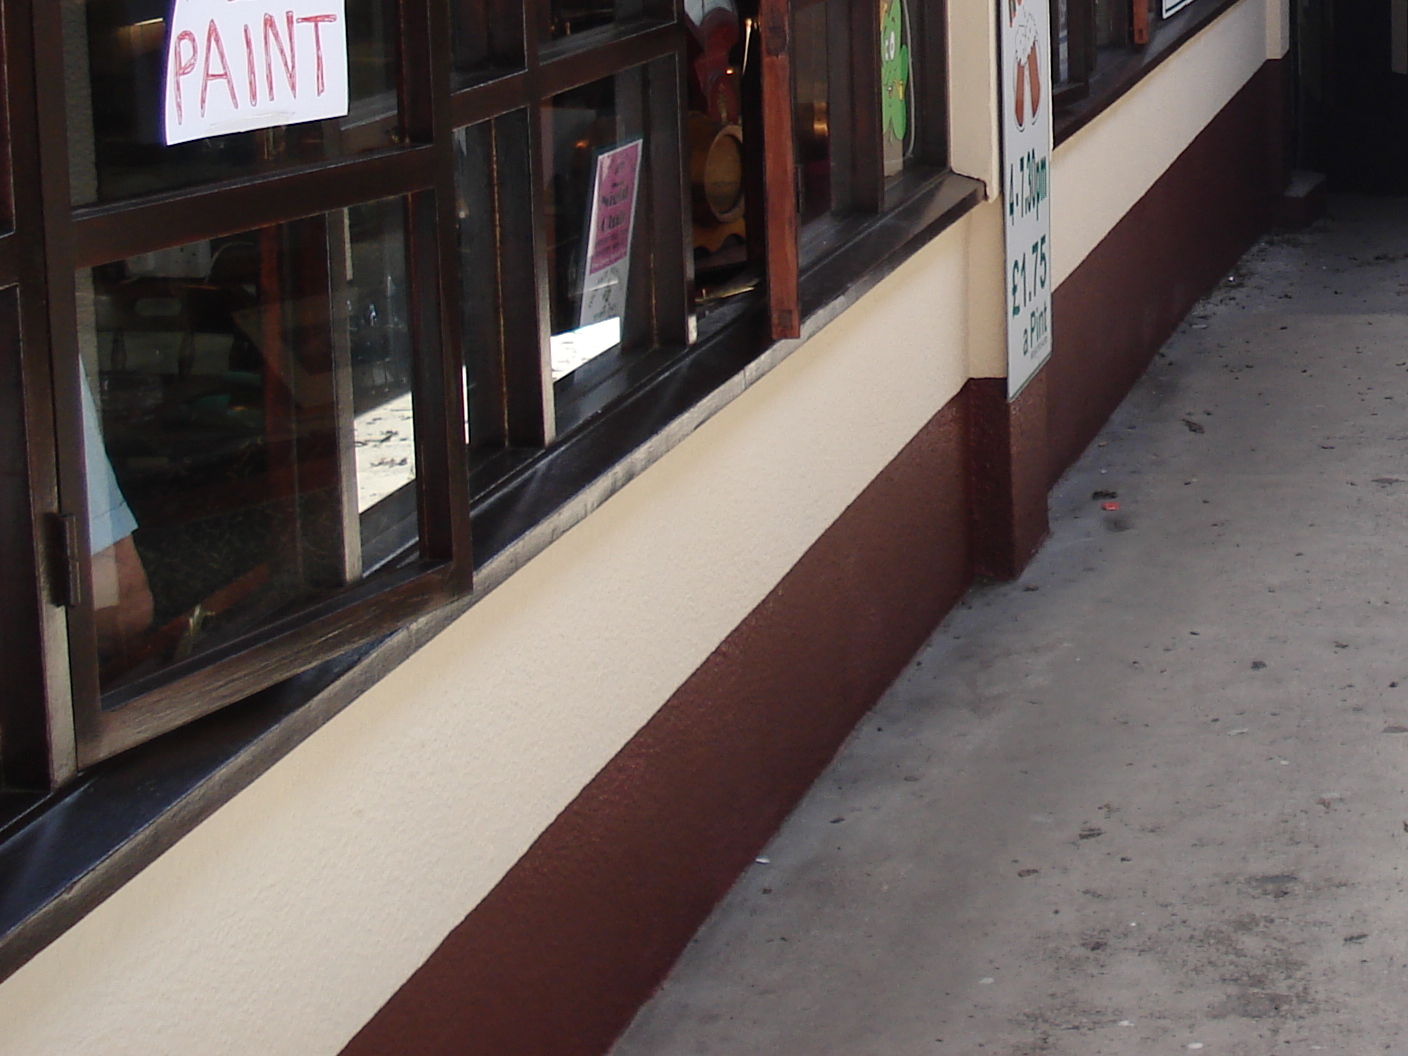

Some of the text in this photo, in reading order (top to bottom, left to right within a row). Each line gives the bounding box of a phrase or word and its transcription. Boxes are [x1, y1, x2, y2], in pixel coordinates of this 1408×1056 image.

[173, 10, 338, 126] PAINT
[1011, 234, 1048, 320] £1.75
[1022, 328, 1029, 356] a
[1030, 301, 1048, 350] Pint
